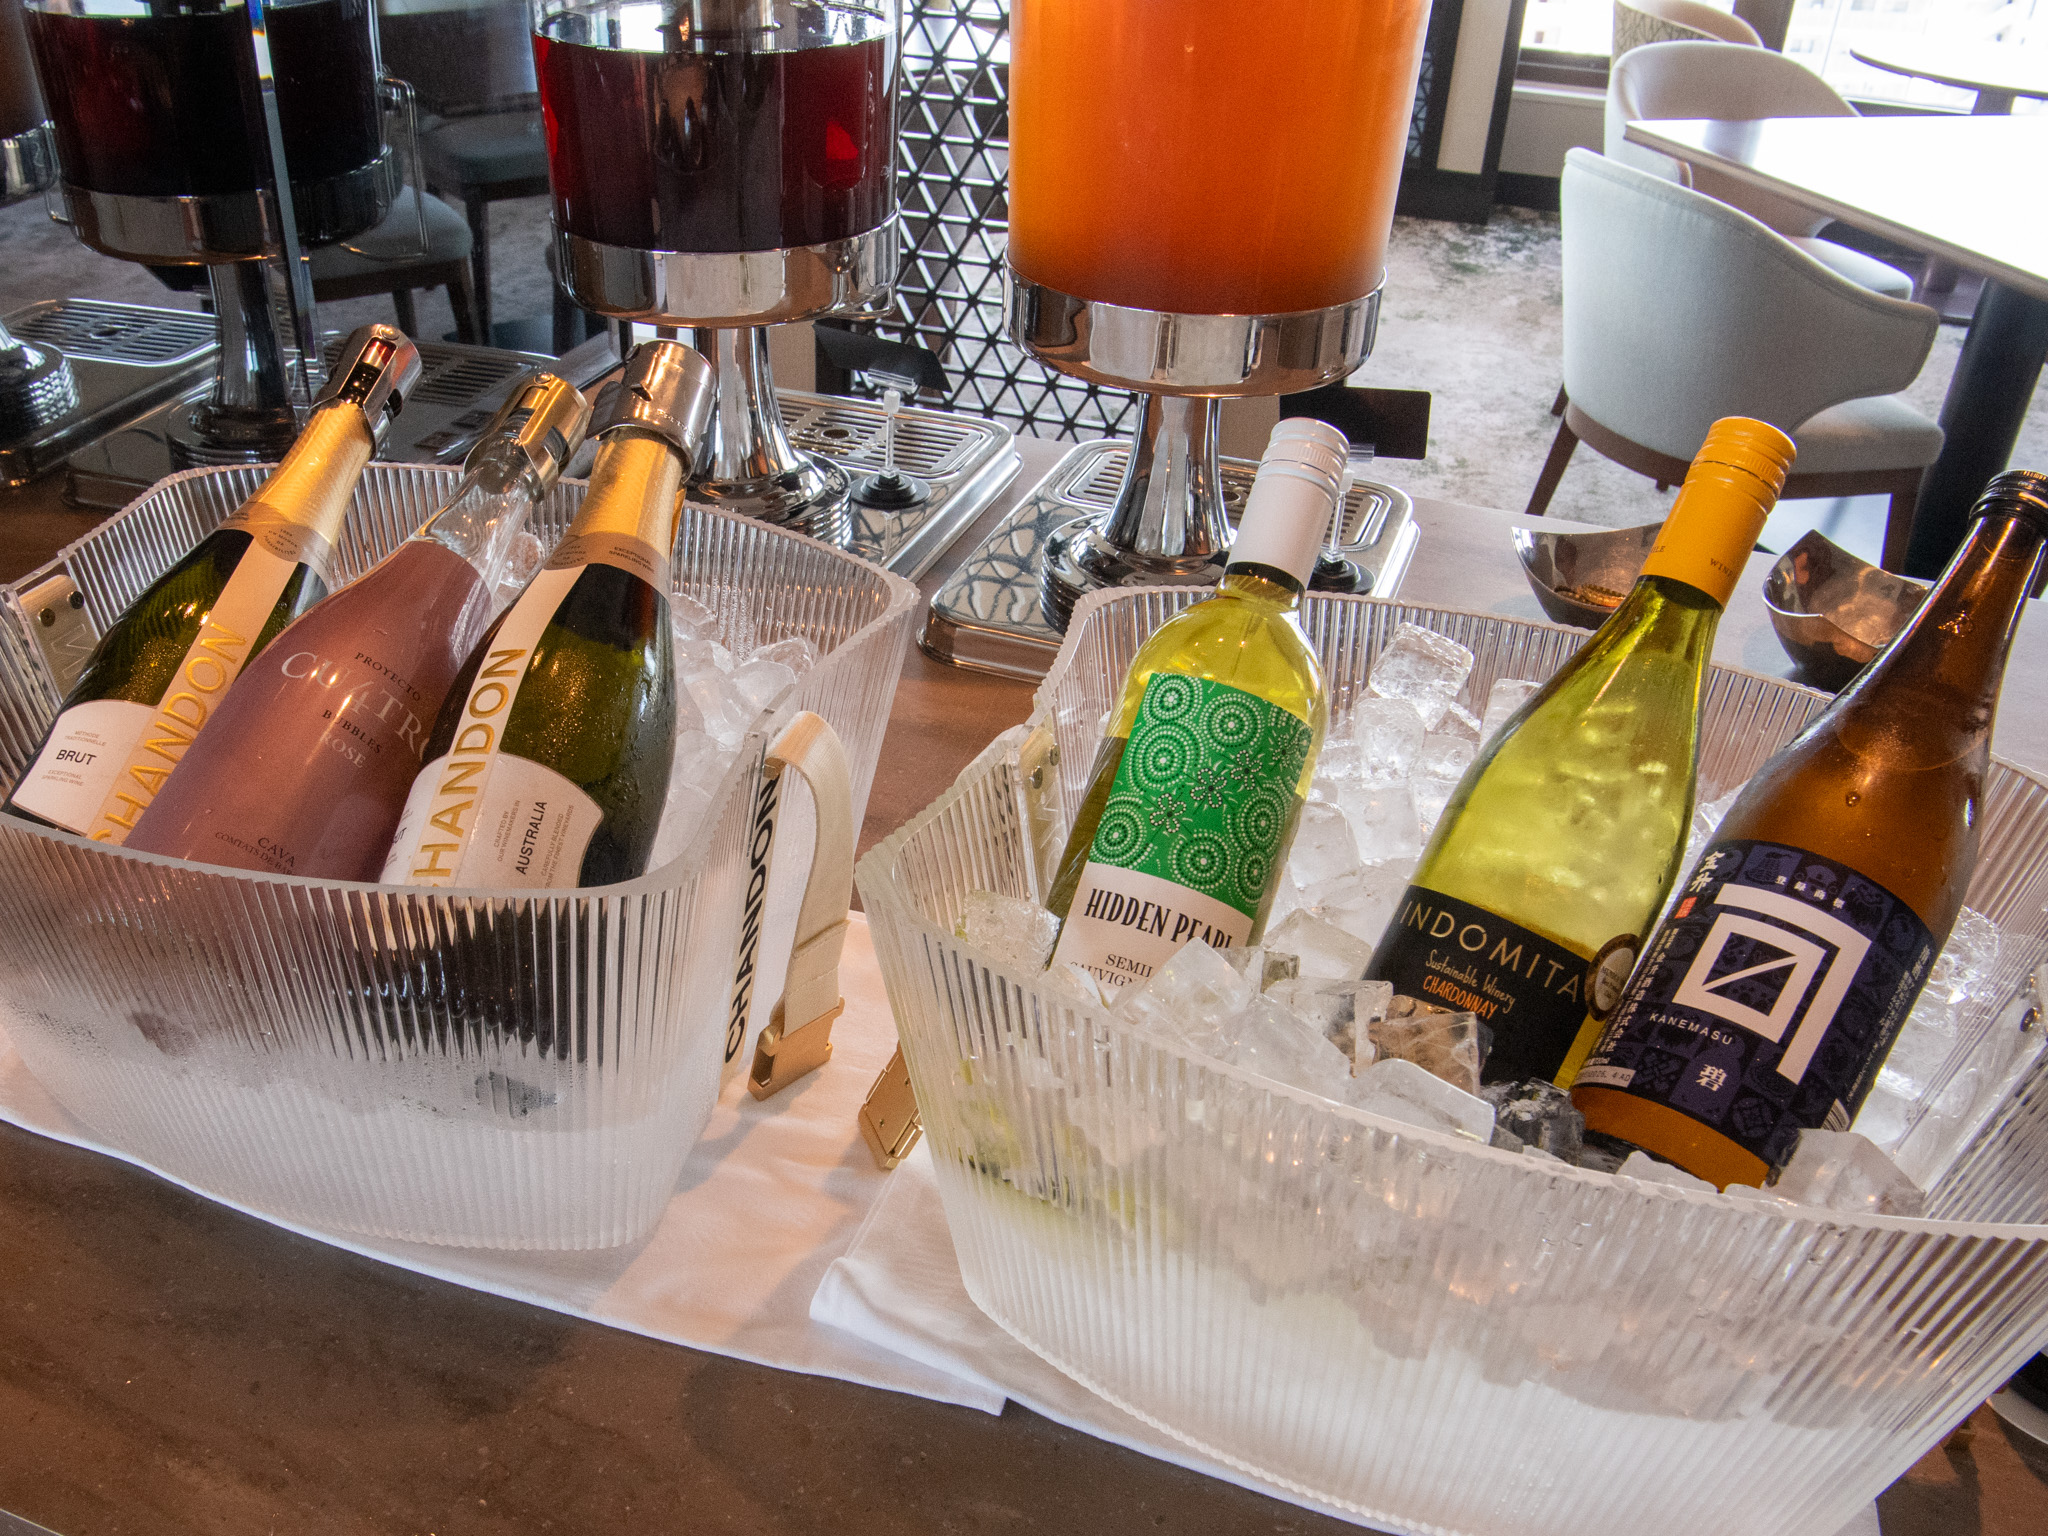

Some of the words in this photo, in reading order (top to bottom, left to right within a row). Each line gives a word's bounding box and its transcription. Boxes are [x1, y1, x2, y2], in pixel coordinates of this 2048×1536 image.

[354, 651, 422, 702] PROYECTO
[56, 749, 97, 765] BRUT
[91, 622, 248, 842] HANDON
[322, 709, 382, 754] BUBBLES
[412, 648, 528, 887] HANDON
[257, 837, 296, 868] CAVA
[515, 801, 548, 875] AUSTRALIA
[725, 772, 780, 1063] CHANDON
[1083, 887, 1172, 938] HIDDEN
[1399, 899, 1582, 1003] INDOMITA
[1423, 975, 1499, 1020] CHARDONNAY
[1425, 948, 1478, 988] Sustainable
[1482, 973, 1516, 1014] Winery
[1649, 1012, 1733, 1045] KANEMASU
[1695, 1063, 1728, 1092] 碧
